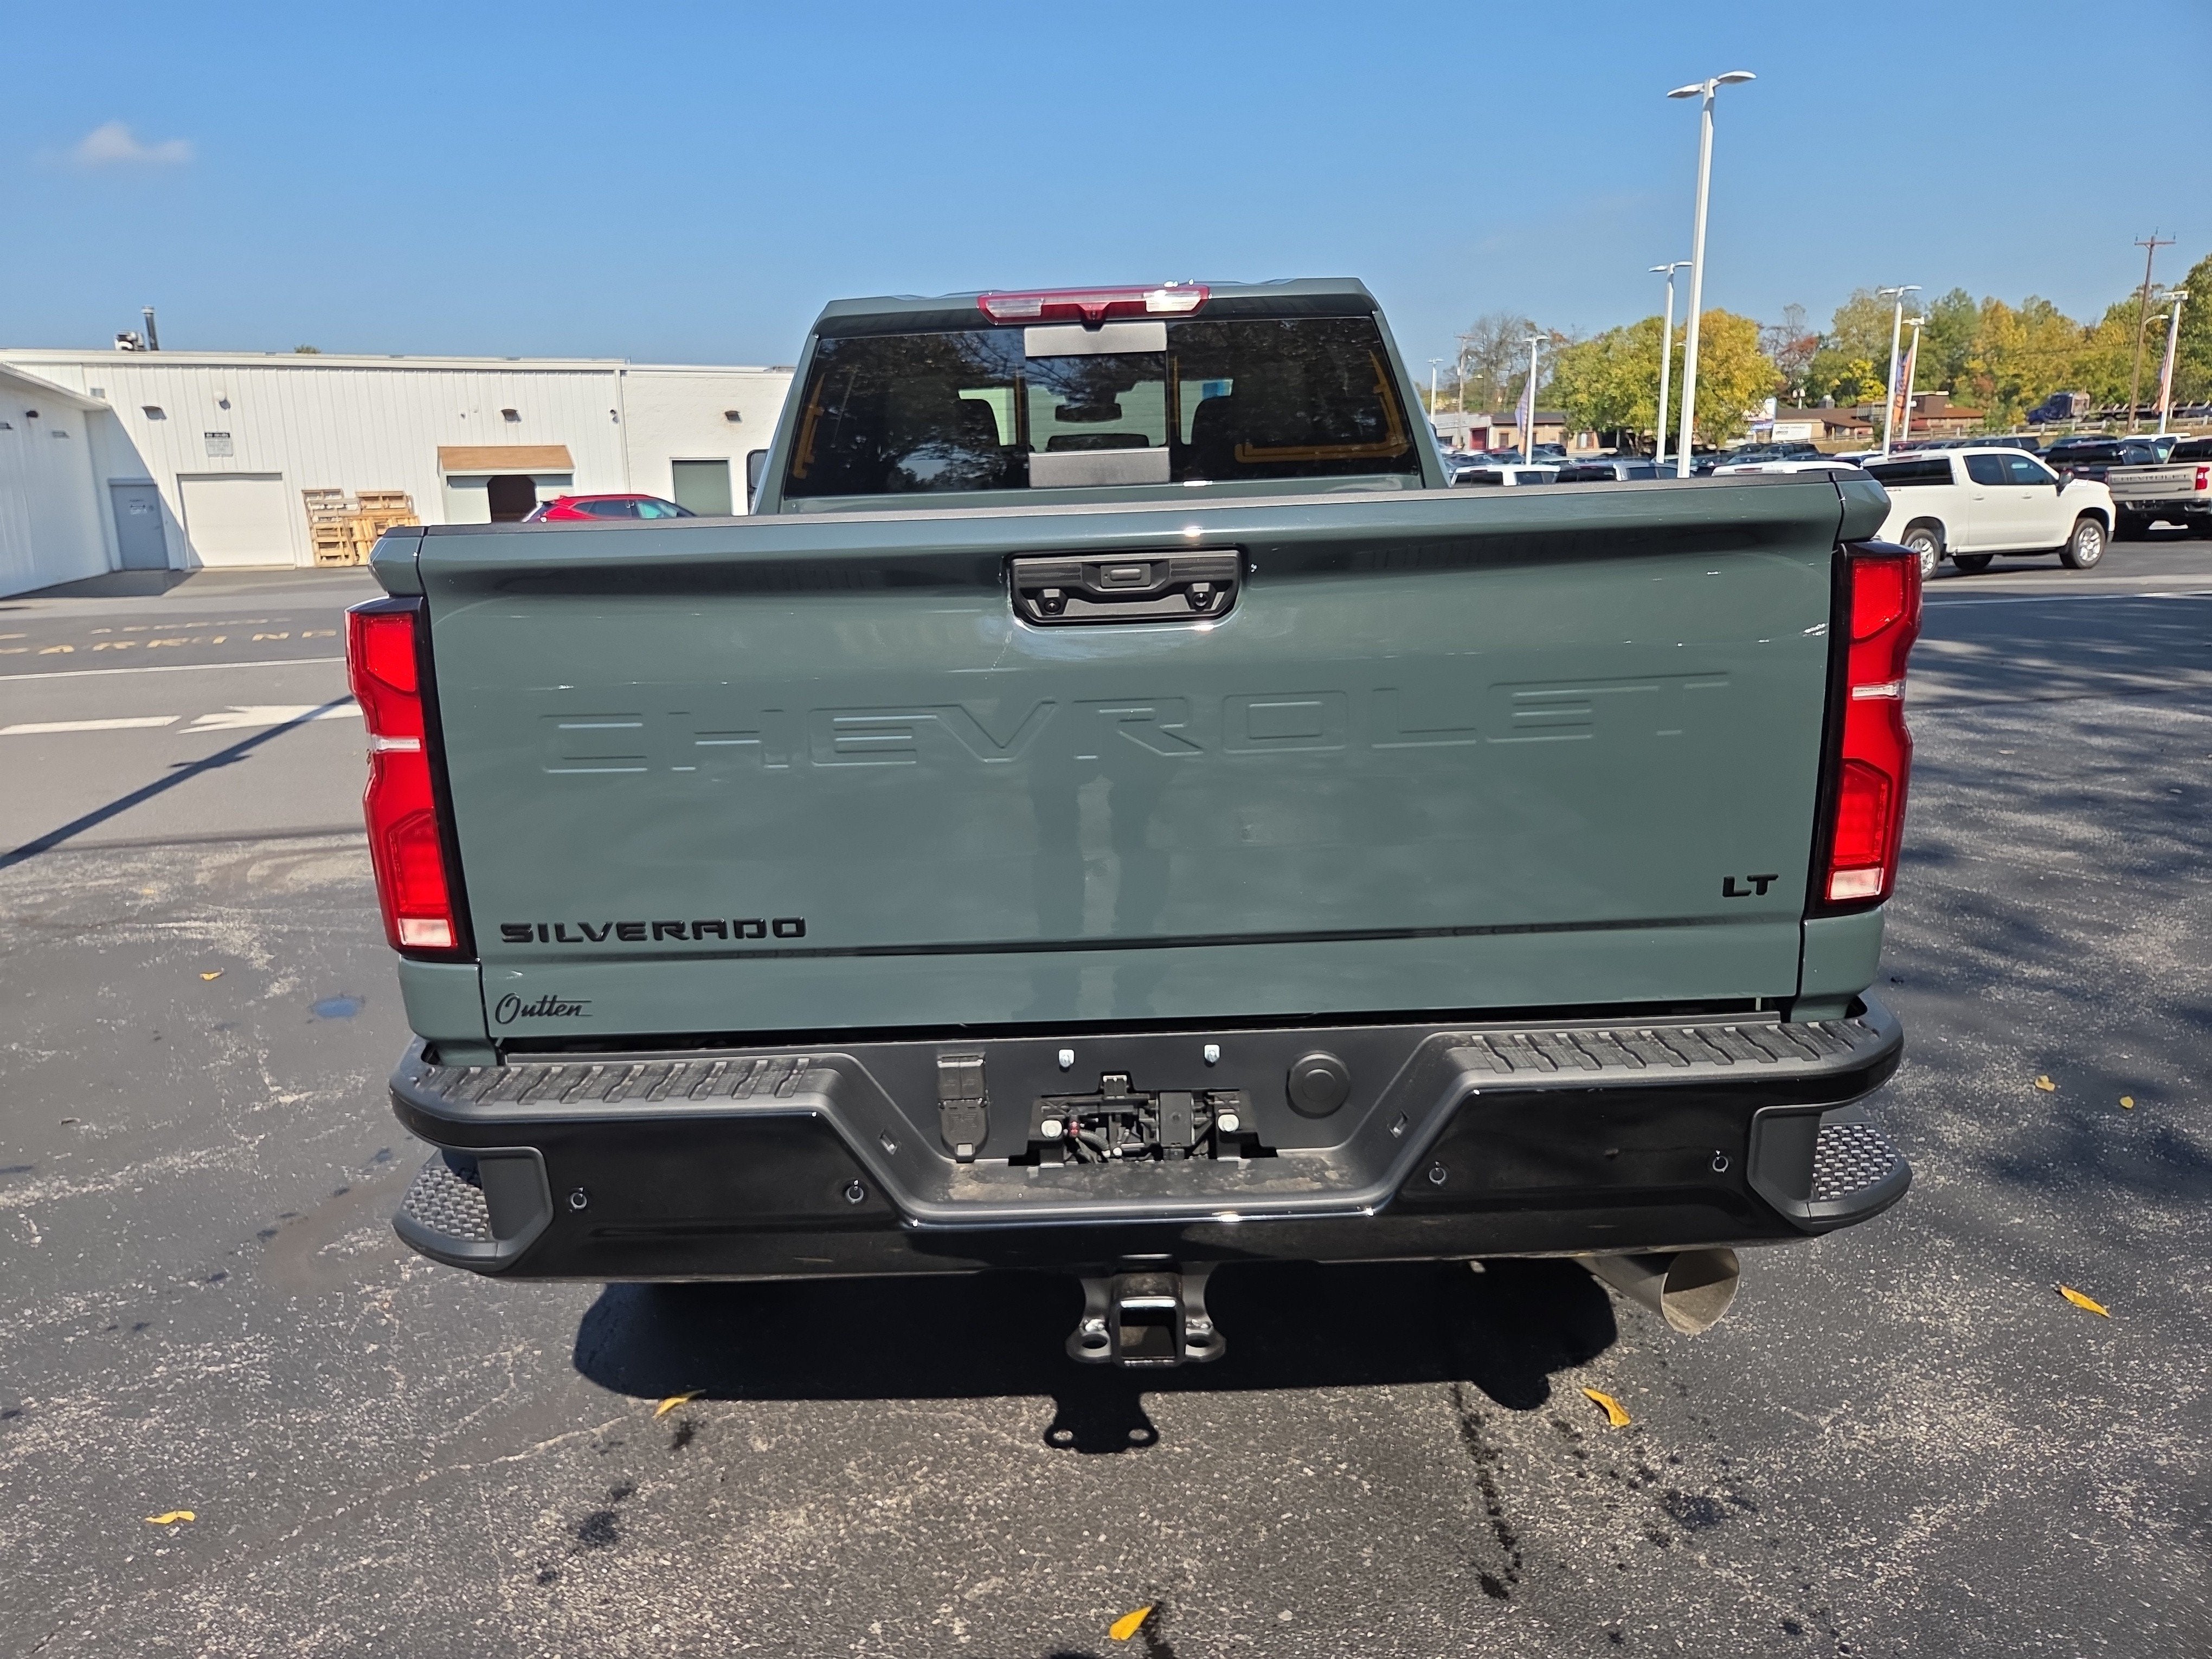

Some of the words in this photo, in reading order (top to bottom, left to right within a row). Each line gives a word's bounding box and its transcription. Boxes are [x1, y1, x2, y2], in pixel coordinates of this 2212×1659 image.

[539, 671, 1729, 773] CHEVROLET
[1722, 873, 1779, 897] LT
[500, 916, 807, 943] SILVERADO
[494, 992, 593, 1025] Outten
